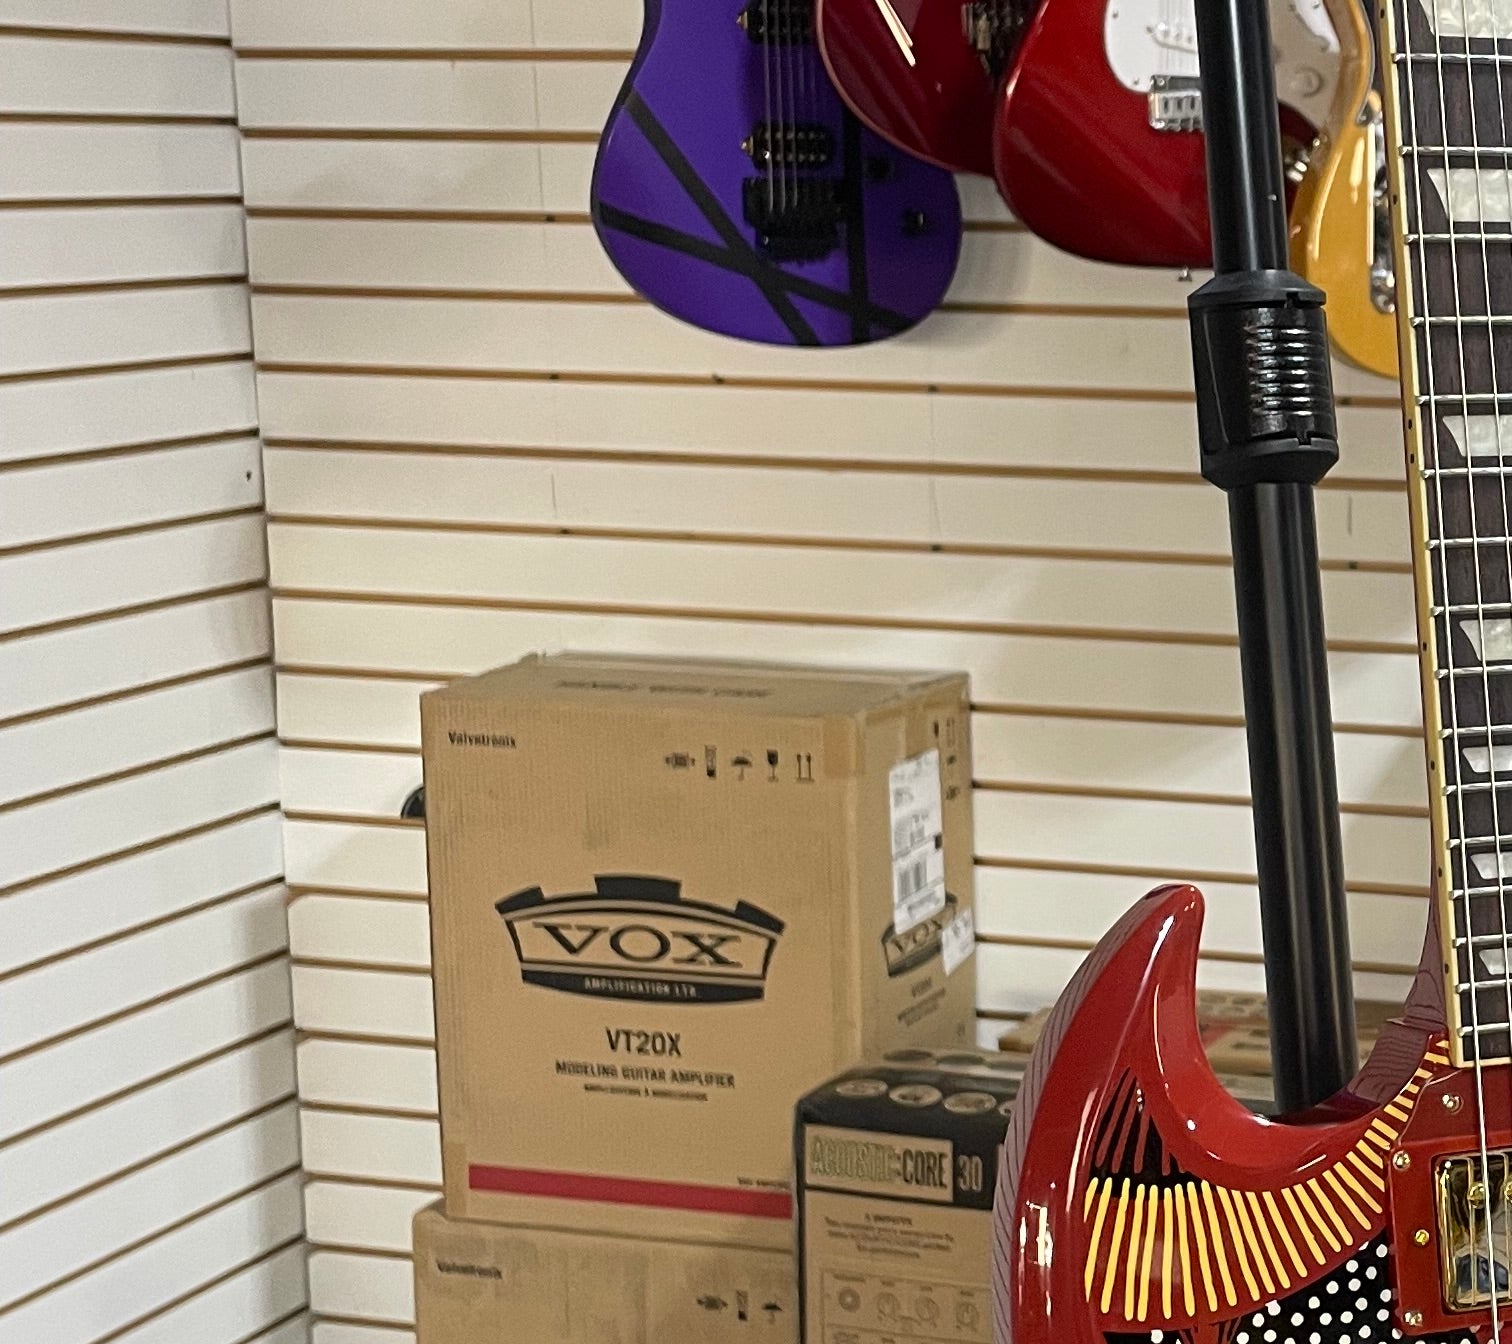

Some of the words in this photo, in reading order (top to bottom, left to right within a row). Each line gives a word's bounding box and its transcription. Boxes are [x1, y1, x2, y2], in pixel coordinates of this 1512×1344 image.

[532, 920, 743, 969] VOX
[605, 1025, 682, 1057] VT20X
[555, 1058, 619, 1079] MODELING
[622, 1064, 667, 1084] GUITAR
[670, 1069, 736, 1089] AMPLIFIER
[957, 1154, 984, 1193] 30
